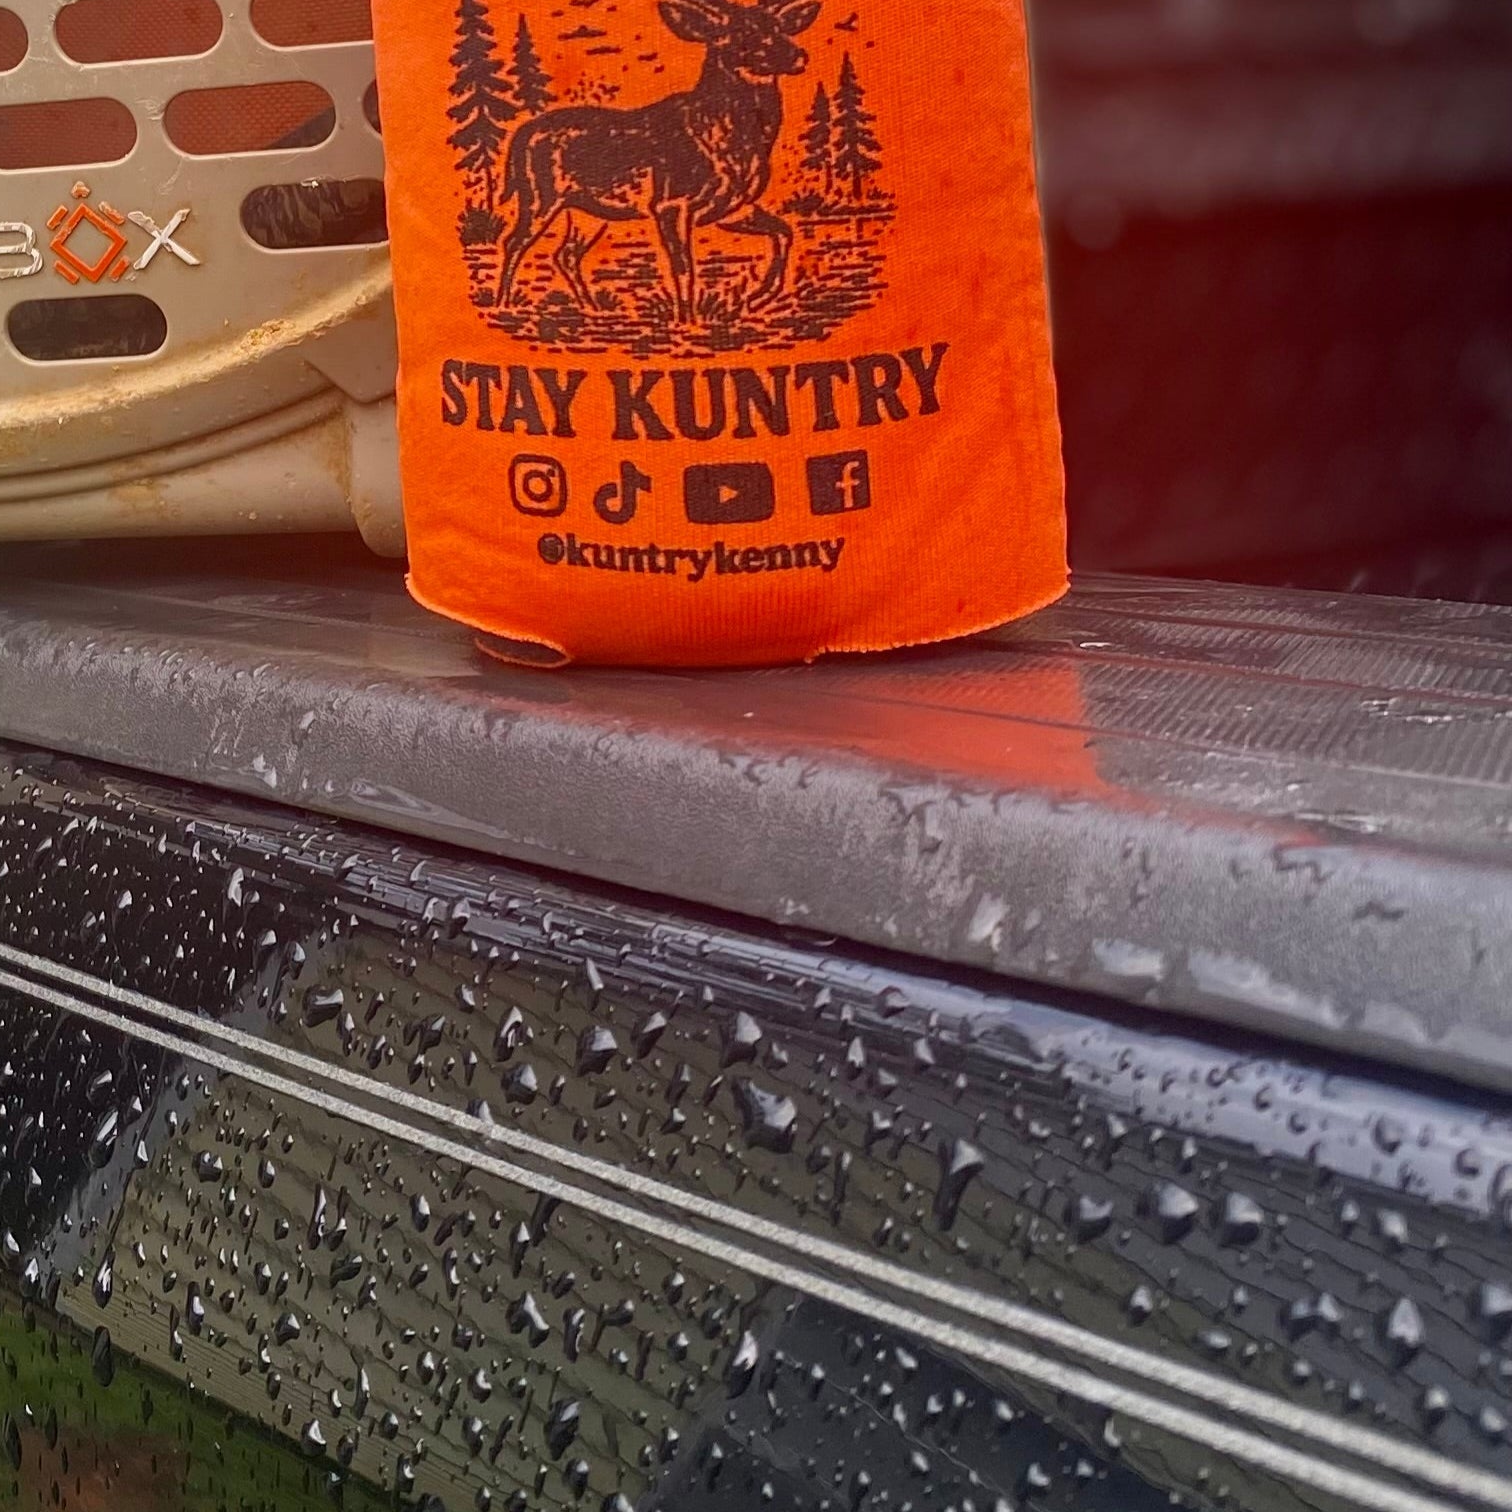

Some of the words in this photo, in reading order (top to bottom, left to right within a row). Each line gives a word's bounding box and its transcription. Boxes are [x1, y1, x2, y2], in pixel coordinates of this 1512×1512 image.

[441, 358, 586, 438] STAY
[606, 342, 951, 441] KUNTRY
[537, 532, 845, 582] @kuntrykenny
